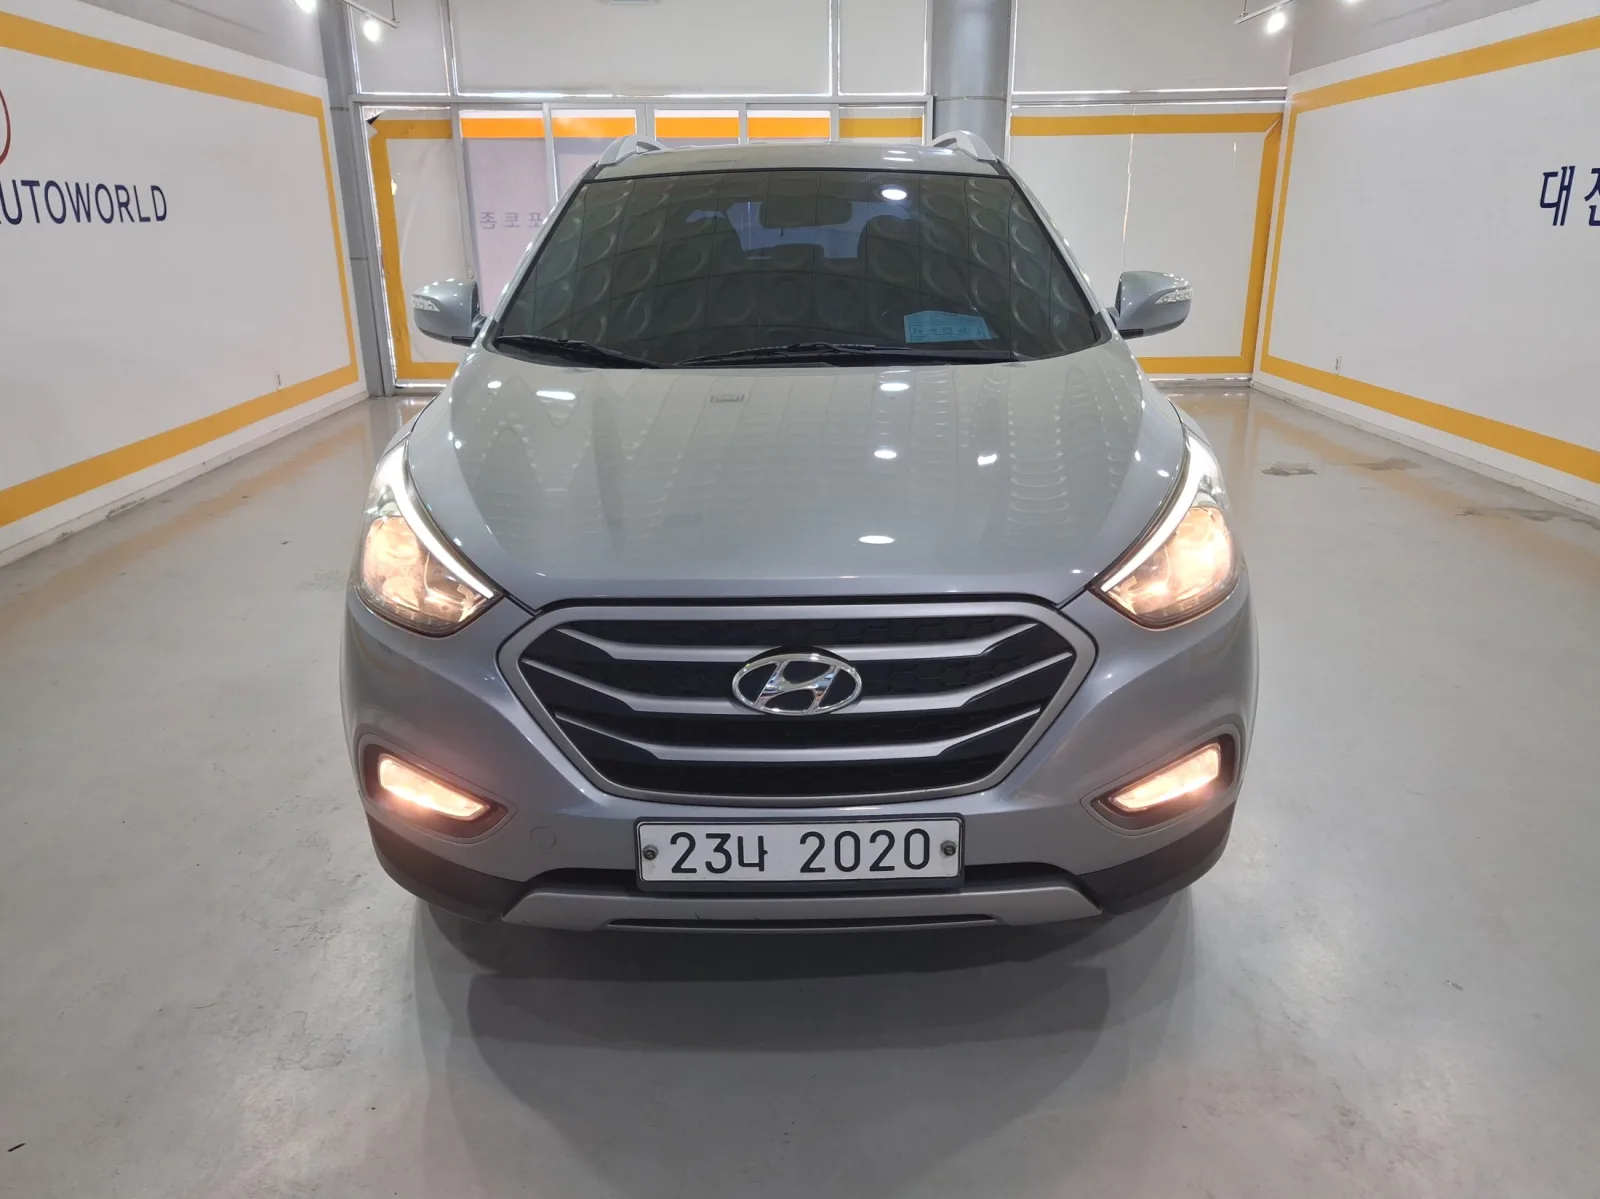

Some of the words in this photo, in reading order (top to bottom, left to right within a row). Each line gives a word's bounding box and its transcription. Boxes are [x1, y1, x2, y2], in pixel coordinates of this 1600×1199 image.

[0, 178, 167, 226] UTOWORLD
[669, 831, 768, 875] 23나
[799, 828, 931, 873] 2020
